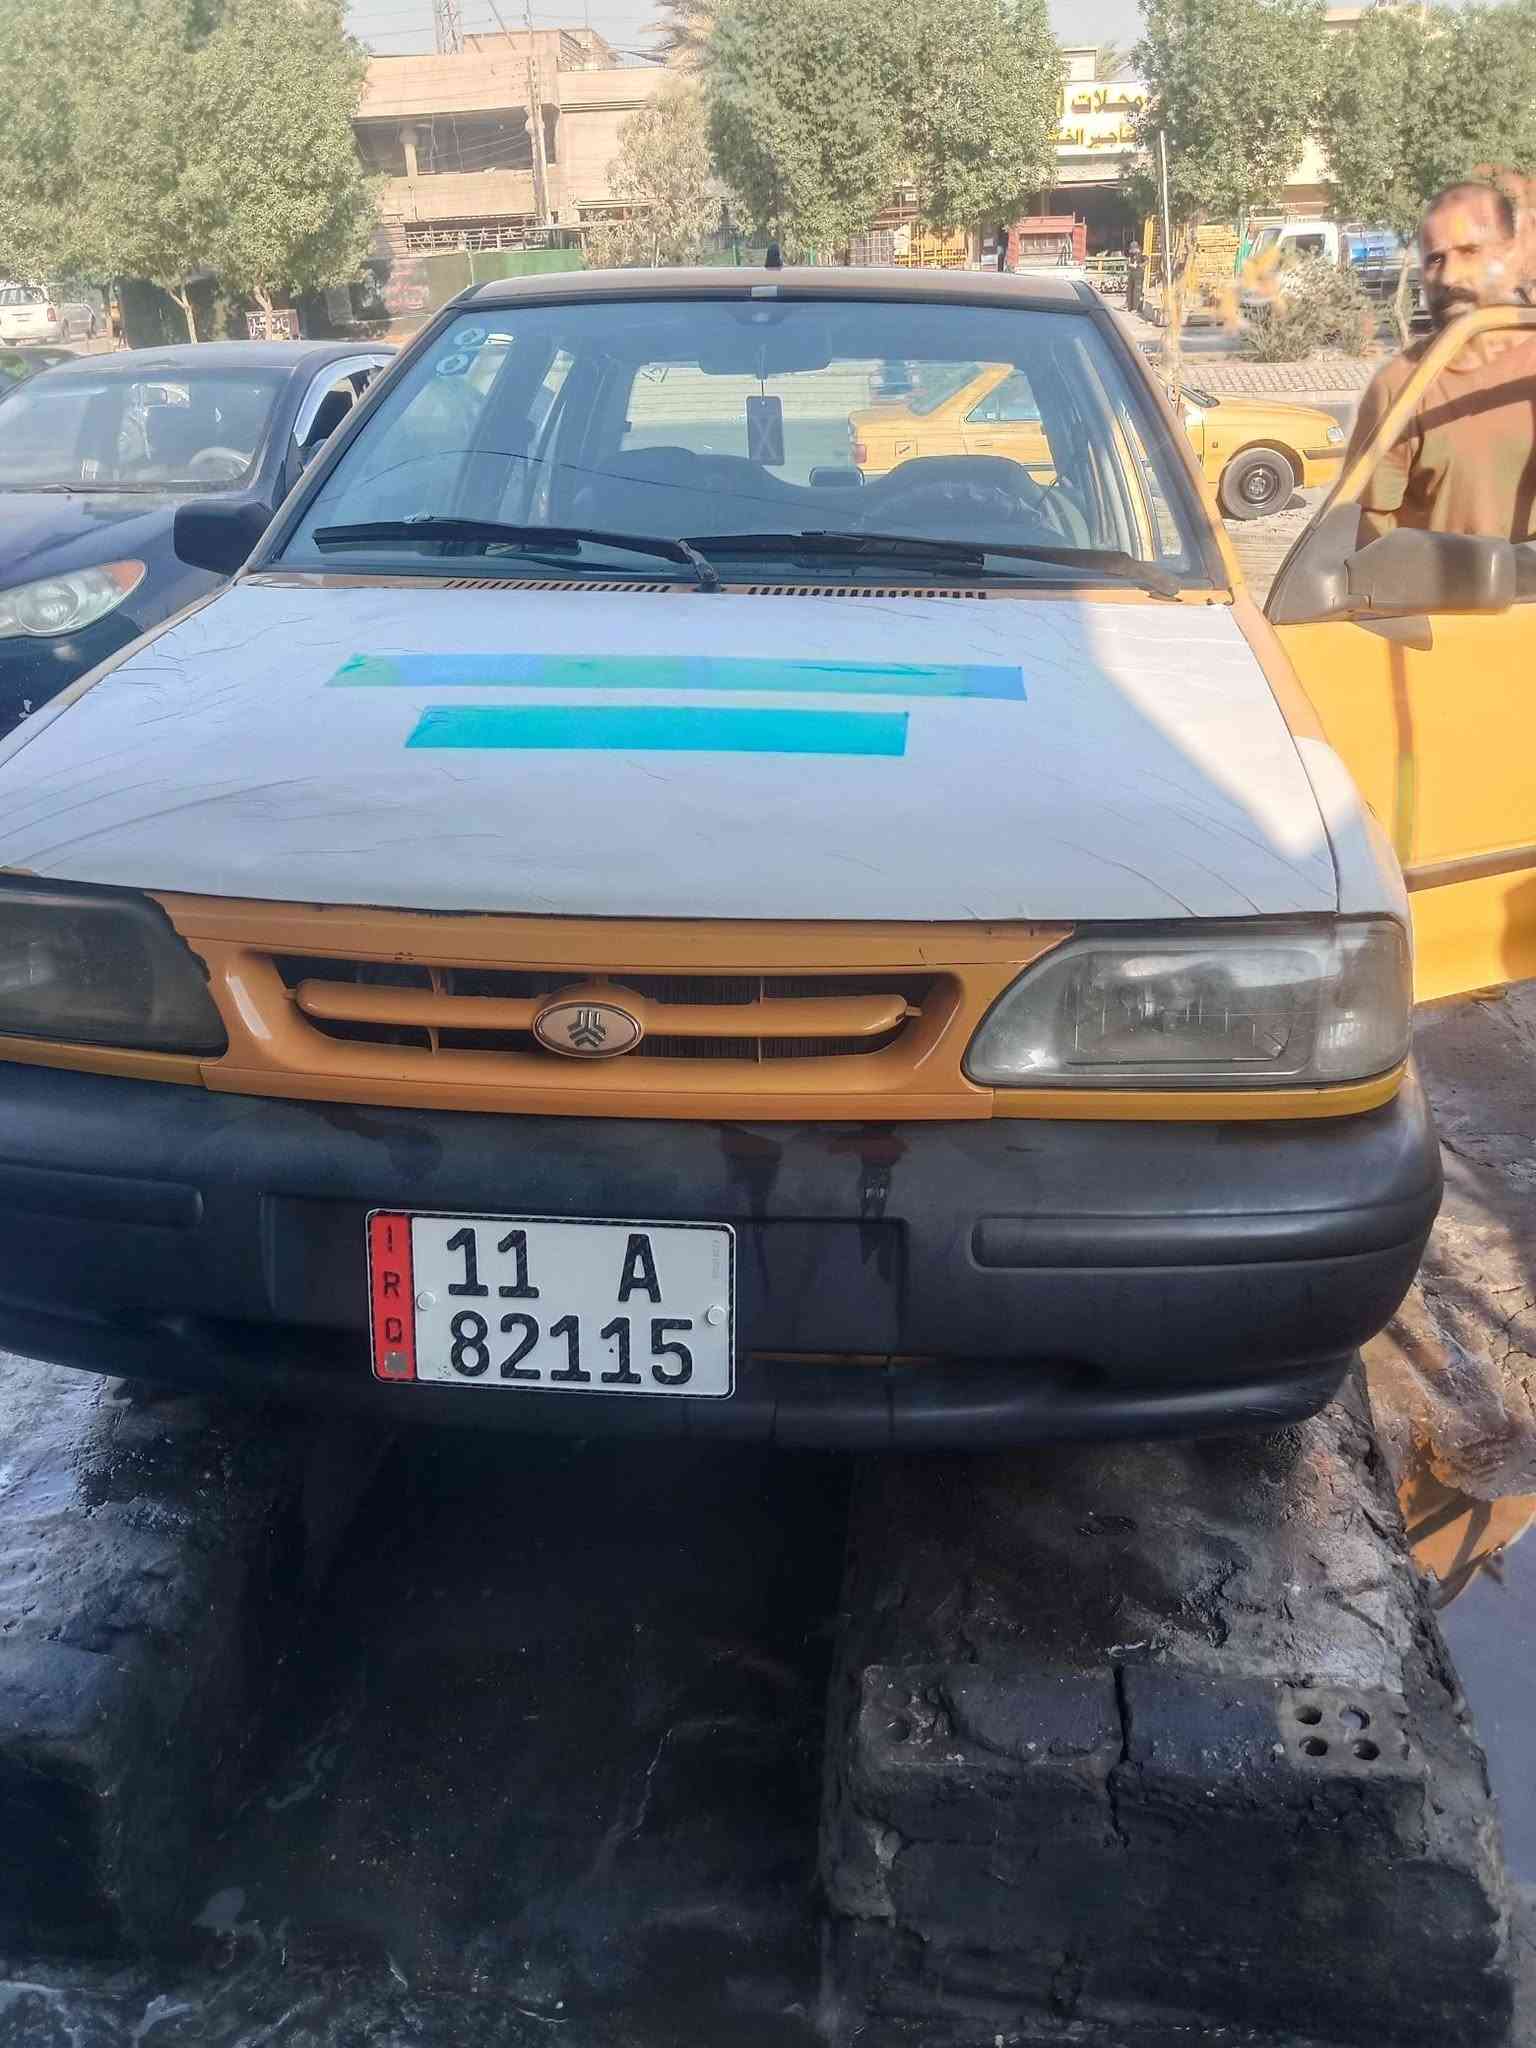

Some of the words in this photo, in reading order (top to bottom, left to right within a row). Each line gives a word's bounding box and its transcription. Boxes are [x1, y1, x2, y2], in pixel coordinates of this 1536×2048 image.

[1071, 88, 1145, 113] محلات
[446, 1227, 541, 1298] 11
[617, 1233, 662, 1303] A
[450, 1310, 694, 1386] 82115
